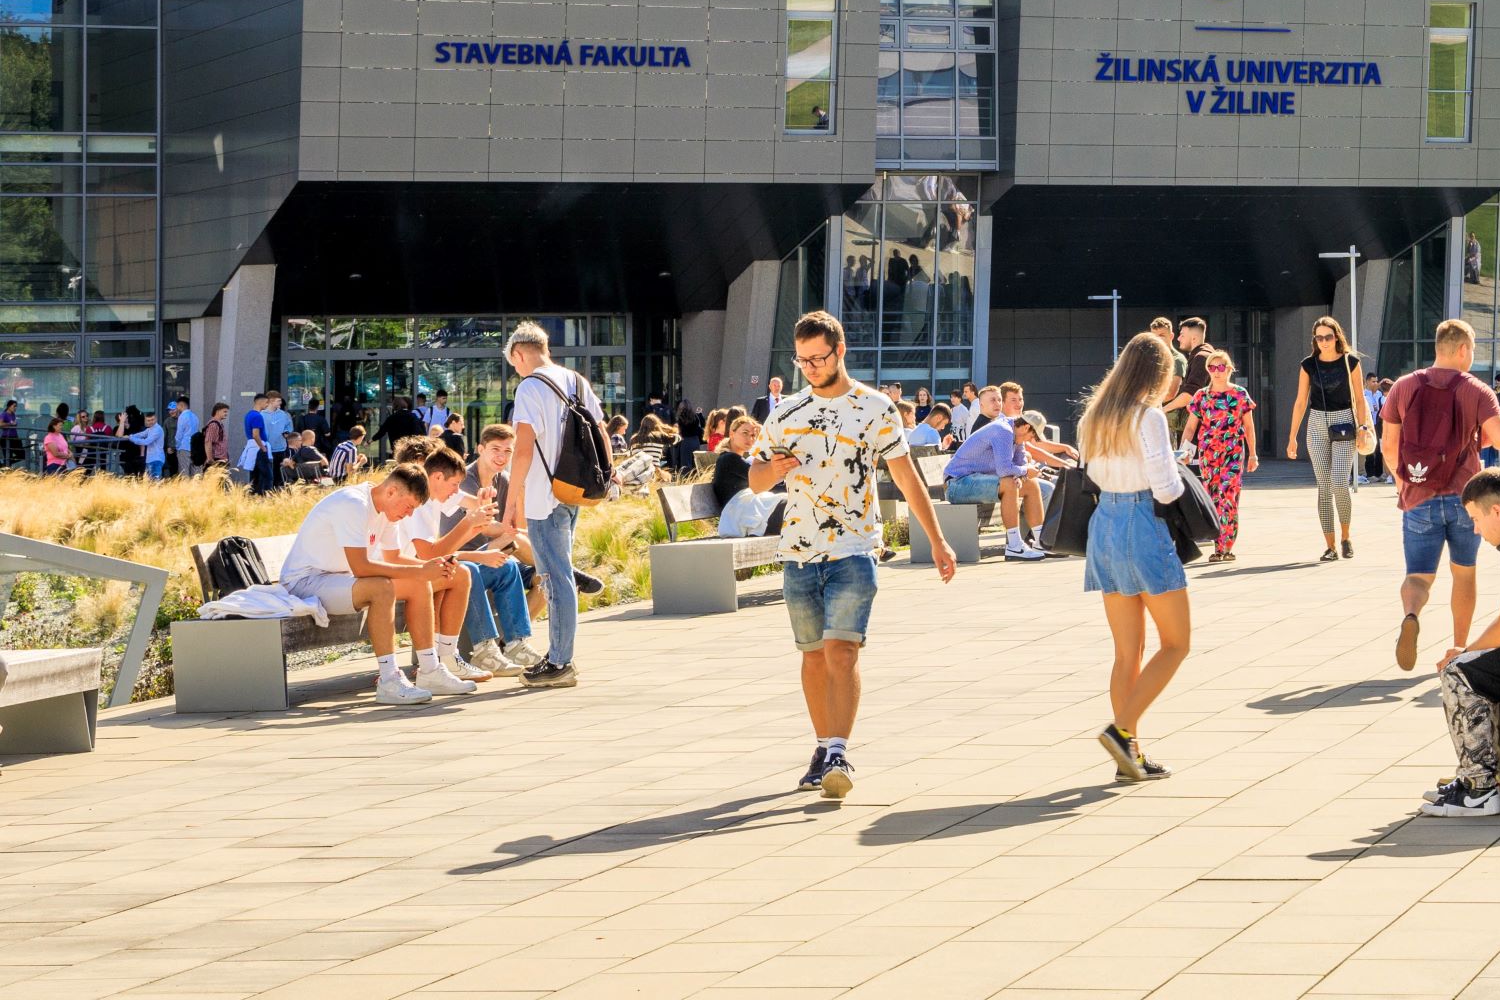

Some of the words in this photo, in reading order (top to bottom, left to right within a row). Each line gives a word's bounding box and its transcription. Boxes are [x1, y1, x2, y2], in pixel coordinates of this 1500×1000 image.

[435, 41, 572, 66] STAVEBNÁ
[579, 45, 691, 67] FAKULTA
[1095, 53, 1218, 82] ŽILINSKÁ
[1227, 60, 1381, 85] UNIVERZITA
[1186, 90, 1206, 113] V
[1210, 86, 1295, 114] ŽILINE
